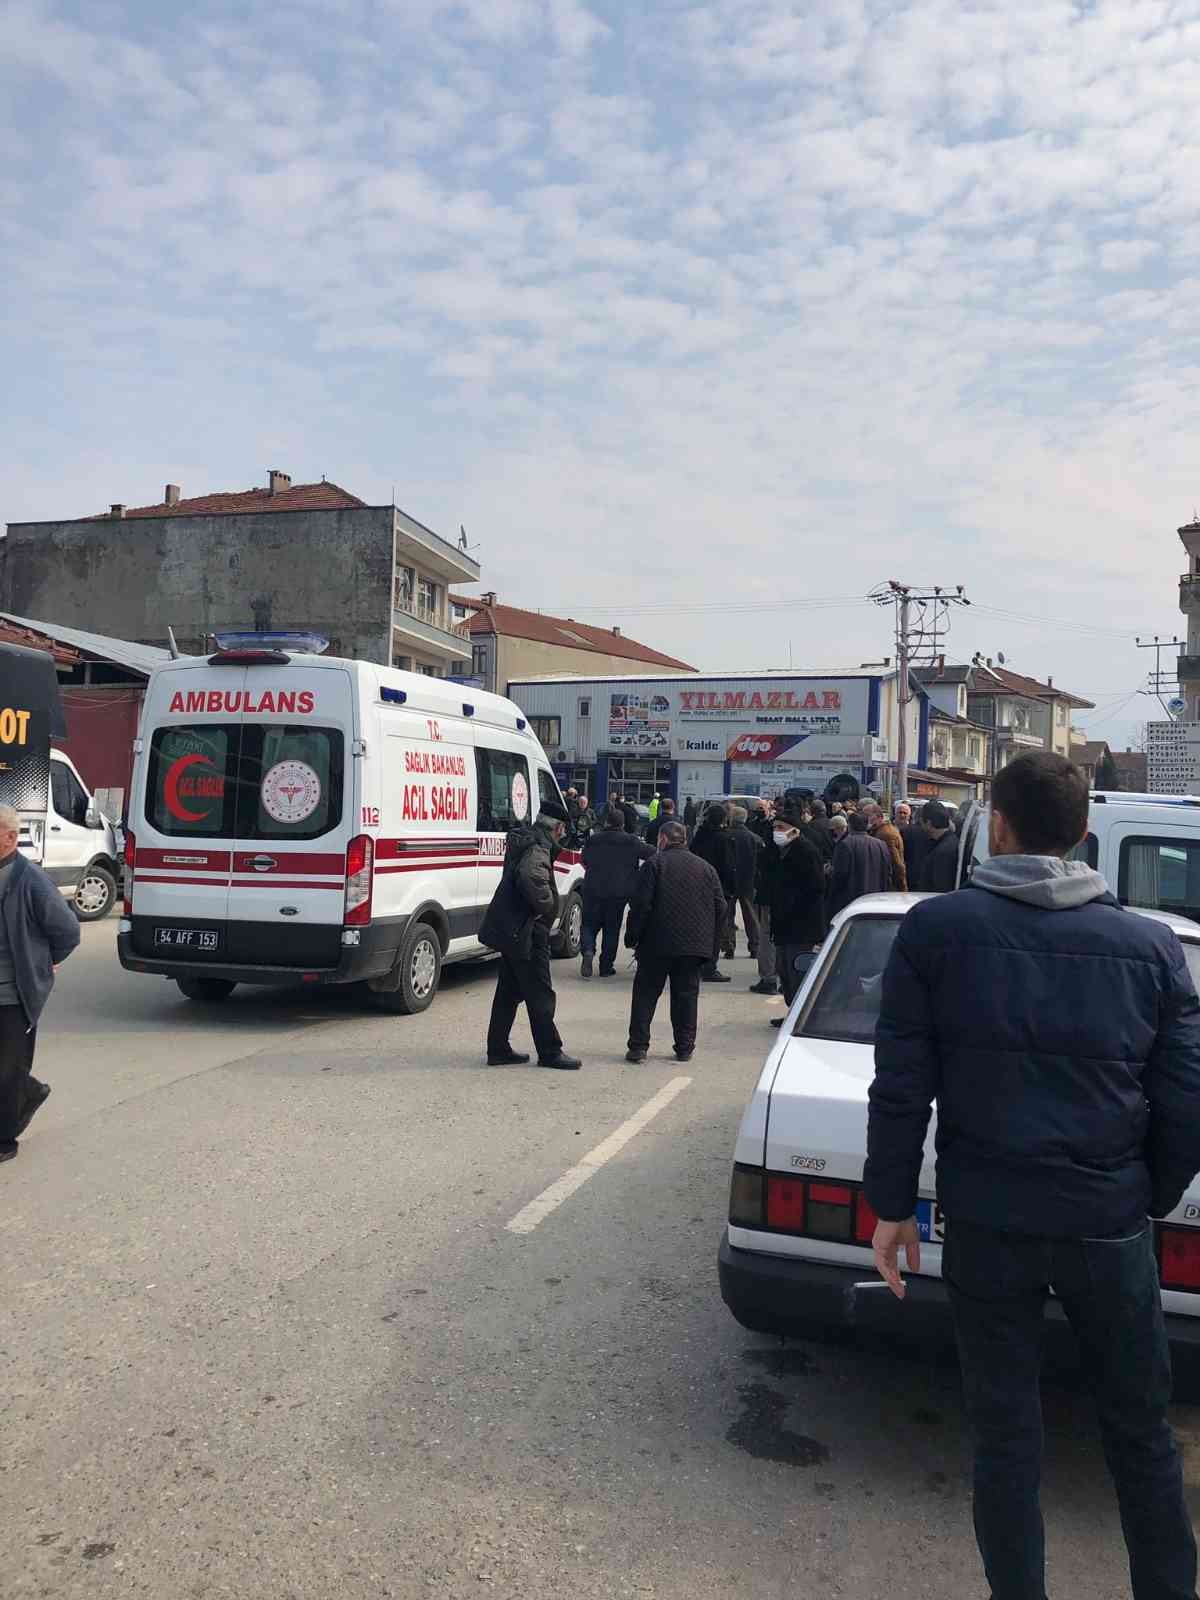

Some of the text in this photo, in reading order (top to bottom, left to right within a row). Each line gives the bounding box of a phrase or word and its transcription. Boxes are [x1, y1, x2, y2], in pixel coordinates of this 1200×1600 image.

[169, 691, 314, 713] AMBULANS
[679, 691, 841, 709] YILMAZLAR
[431, 781, 468, 821] SAĞLIK
[362, 807, 379, 823] 112
[160, 931, 216, 946] 54 AFF 153
